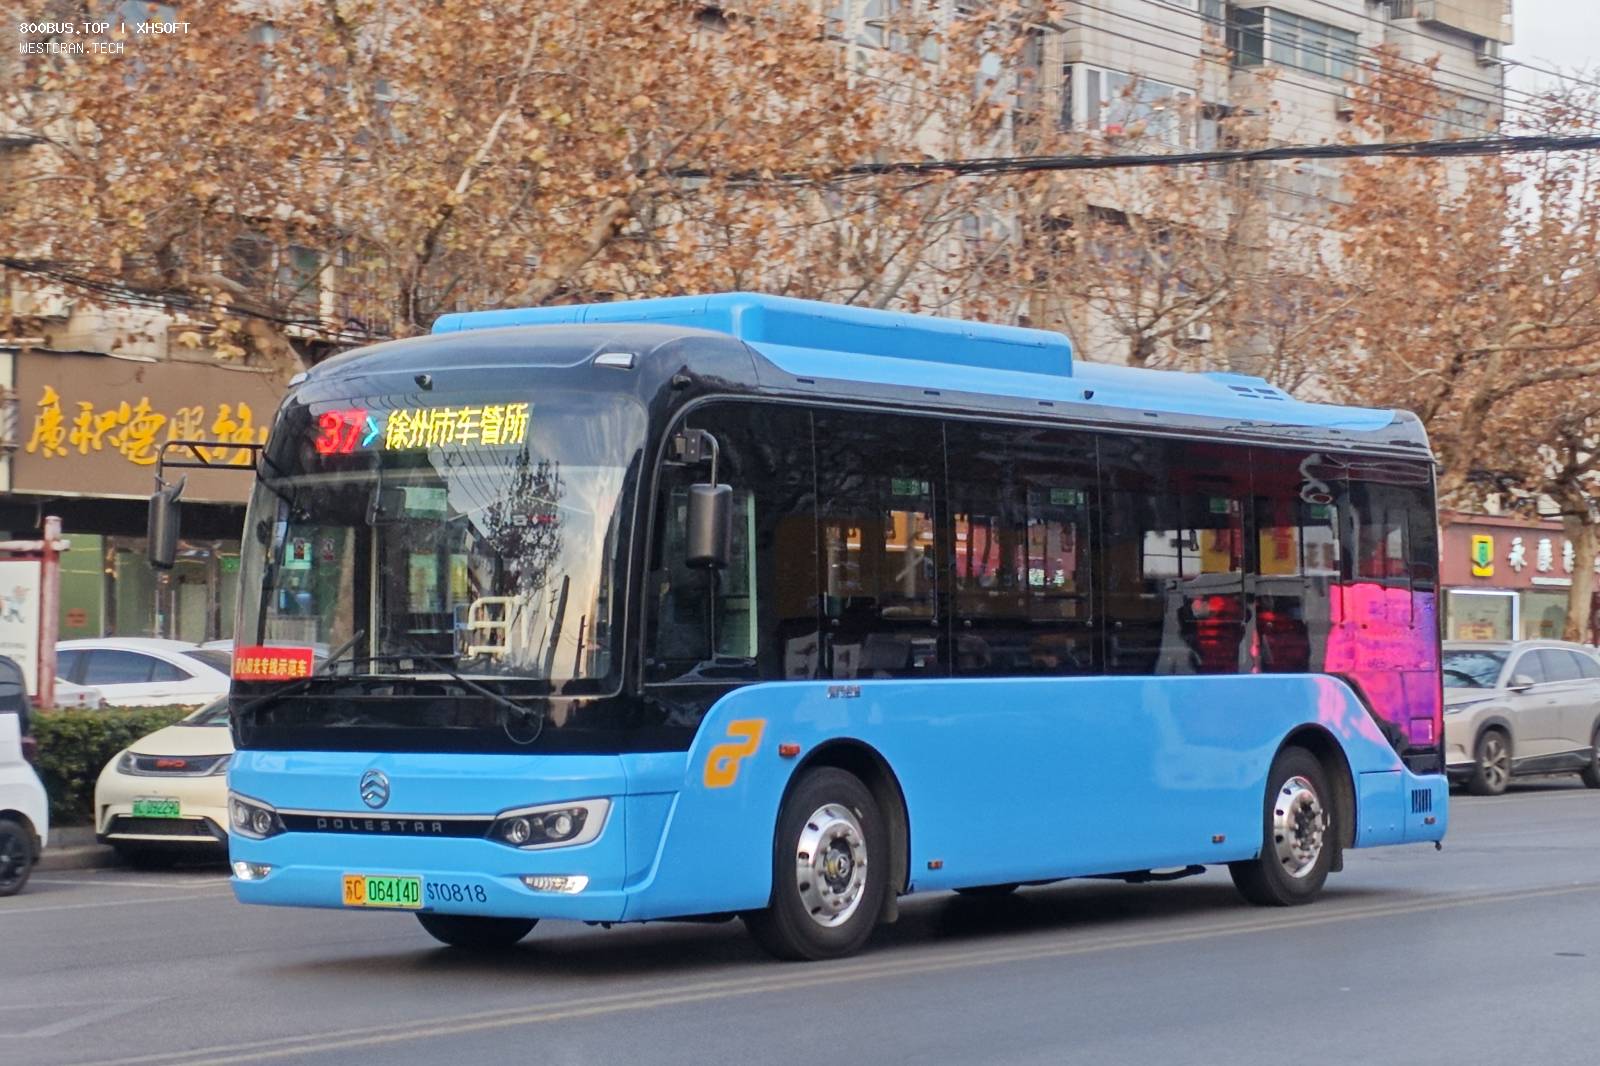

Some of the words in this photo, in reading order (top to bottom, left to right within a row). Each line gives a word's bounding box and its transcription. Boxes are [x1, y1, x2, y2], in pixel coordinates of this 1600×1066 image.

[316, 409, 368, 454] 37
[385, 403, 530, 450] 徐州市车管所
